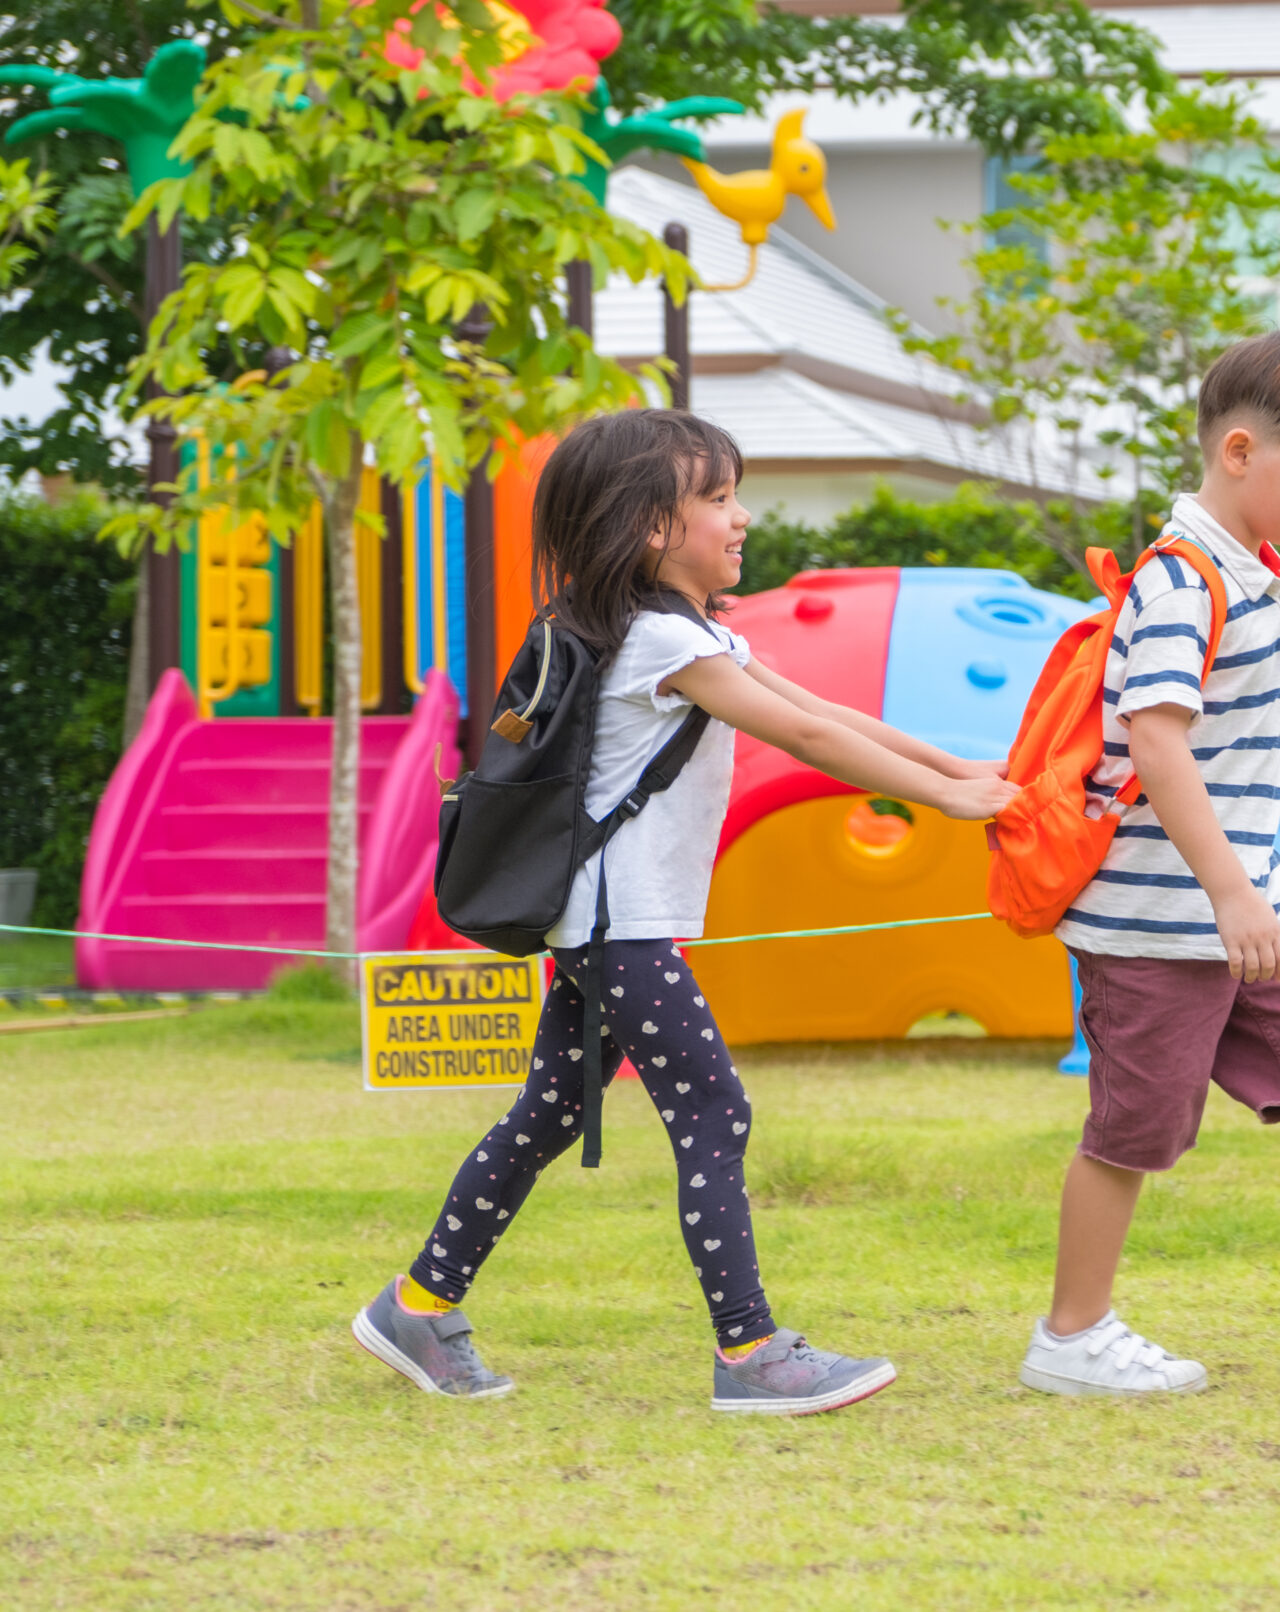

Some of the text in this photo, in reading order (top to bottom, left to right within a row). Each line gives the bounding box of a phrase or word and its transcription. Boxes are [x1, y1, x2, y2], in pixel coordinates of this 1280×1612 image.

[376, 967, 529, 1002] CAUTION
[387, 1013, 521, 1043] AREA UNDER
